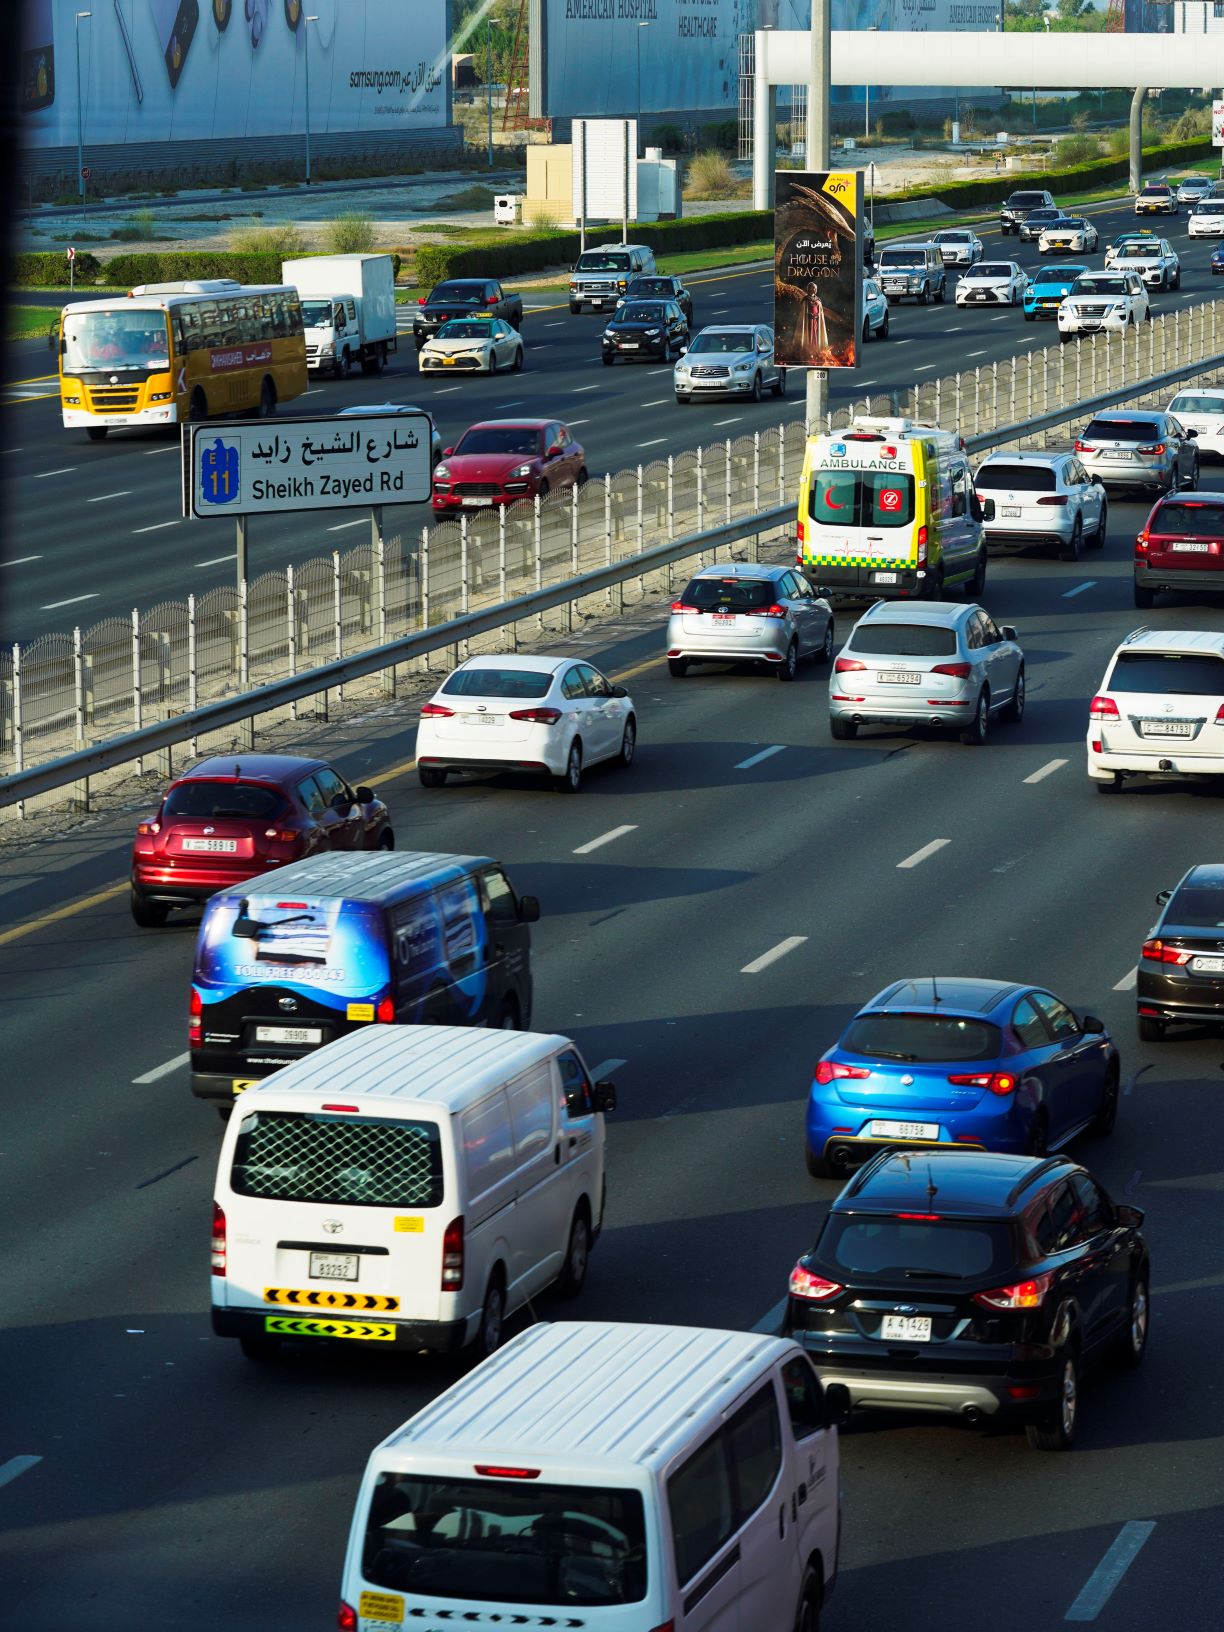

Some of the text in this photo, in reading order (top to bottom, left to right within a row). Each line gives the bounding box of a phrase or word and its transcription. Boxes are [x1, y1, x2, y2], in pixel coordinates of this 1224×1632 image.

[678, 16, 718, 38] HEALTHCARE
[349, 70, 400, 95] samsung.com
[789, 253, 828, 265] HOUSE
[787, 266, 840, 278] DRAGON
[251, 429, 419, 466] شارع الشيخ زايد
[820, 458, 907, 471] AMBULANCE
[210, 470, 230, 497] 11
[252, 470, 404, 500] Sheikh Zayed Rd
